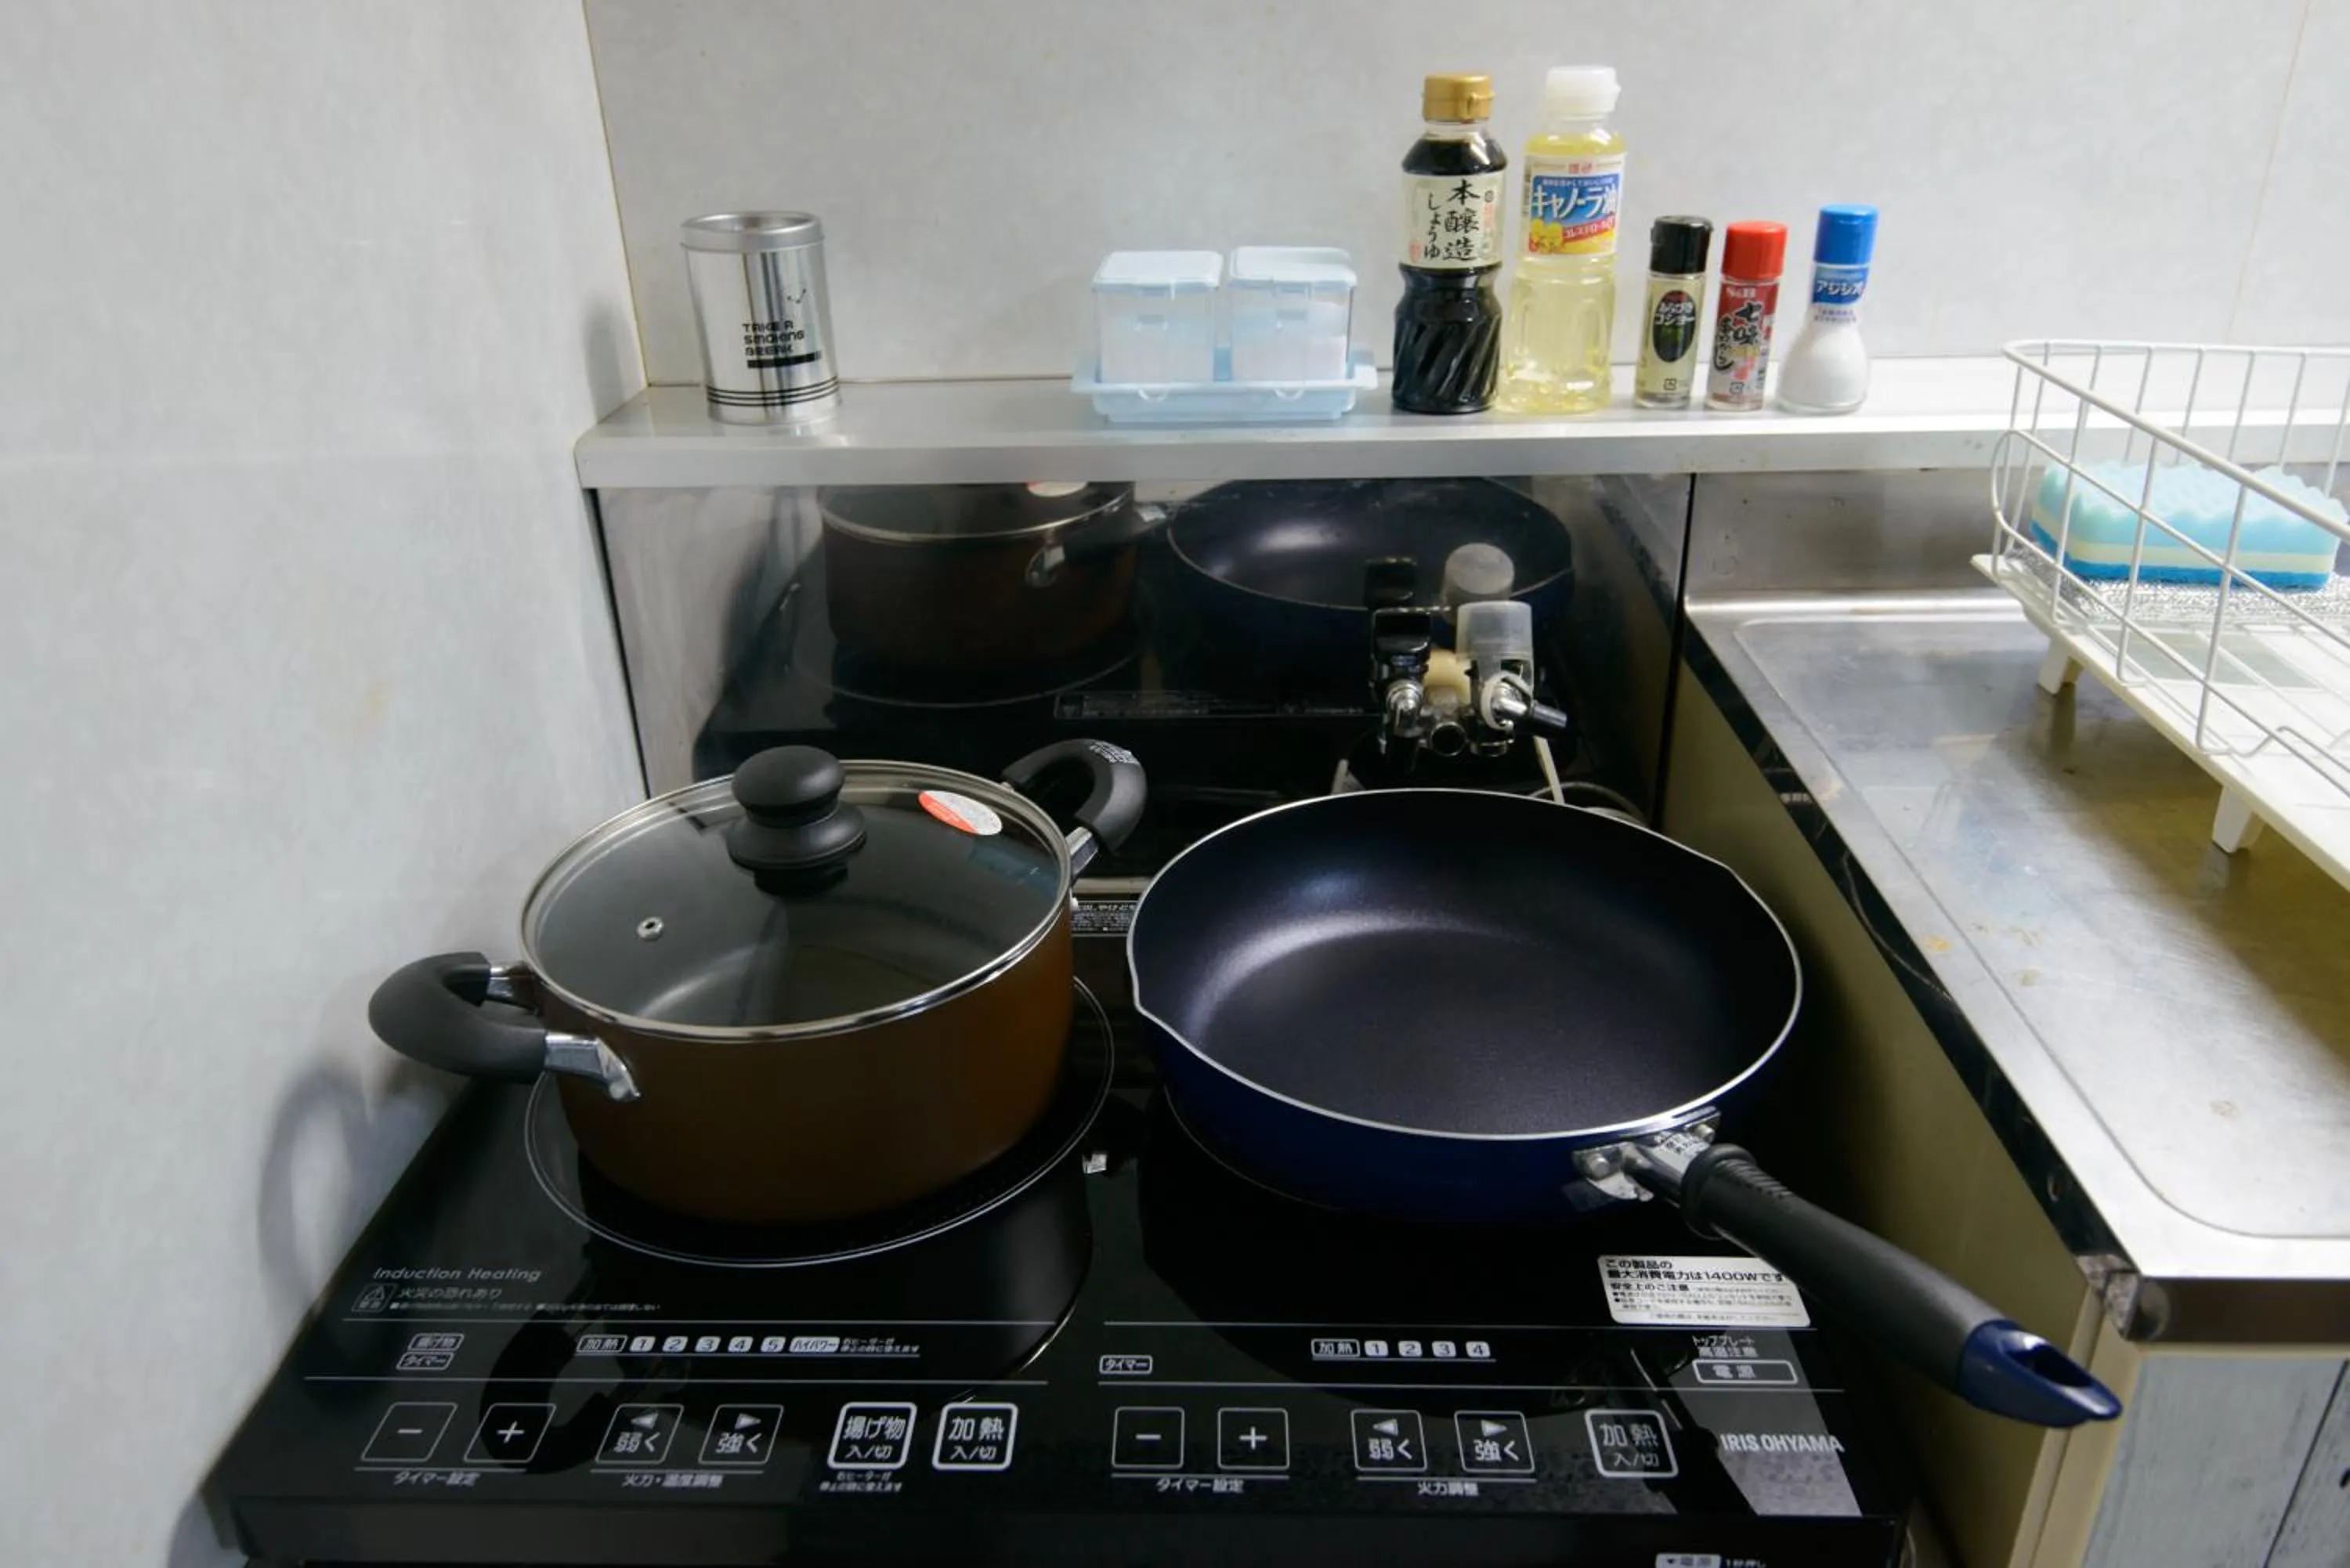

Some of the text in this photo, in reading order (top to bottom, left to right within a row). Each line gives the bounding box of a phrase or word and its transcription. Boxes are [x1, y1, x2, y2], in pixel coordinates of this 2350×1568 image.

[1425, 193, 1442, 260] しょうゆ
[1443, 179, 1480, 261] 本醸造
[1605, 1259, 1673, 1269] この製品の
[373, 1267, 542, 1282] Induction Heating
[1318, 1342, 1354, 1355] 加熱
[1104, 1359, 1148, 1371] タイマー
[843, 1415, 906, 1440] 揚げ物
[948, 1416, 1005, 1440] 加熱
[1600, 1422, 1660, 1447] 加熱
[614, 1432, 660, 1453] 弱く
[715, 1432, 762, 1454] 強く
[844, 1444, 893, 1460] 入/切
[1368, 1438, 1412, 1460] 弱く
[1473, 1439, 1520, 1461] 強く
[1720, 1434, 1846, 1453] IRIS OHYAMA
[949, 1445, 997, 1461] 入/切
[393, 1471, 482, 1487] タイマー設定
[1156, 1478, 1246, 1494] タイマー設定
